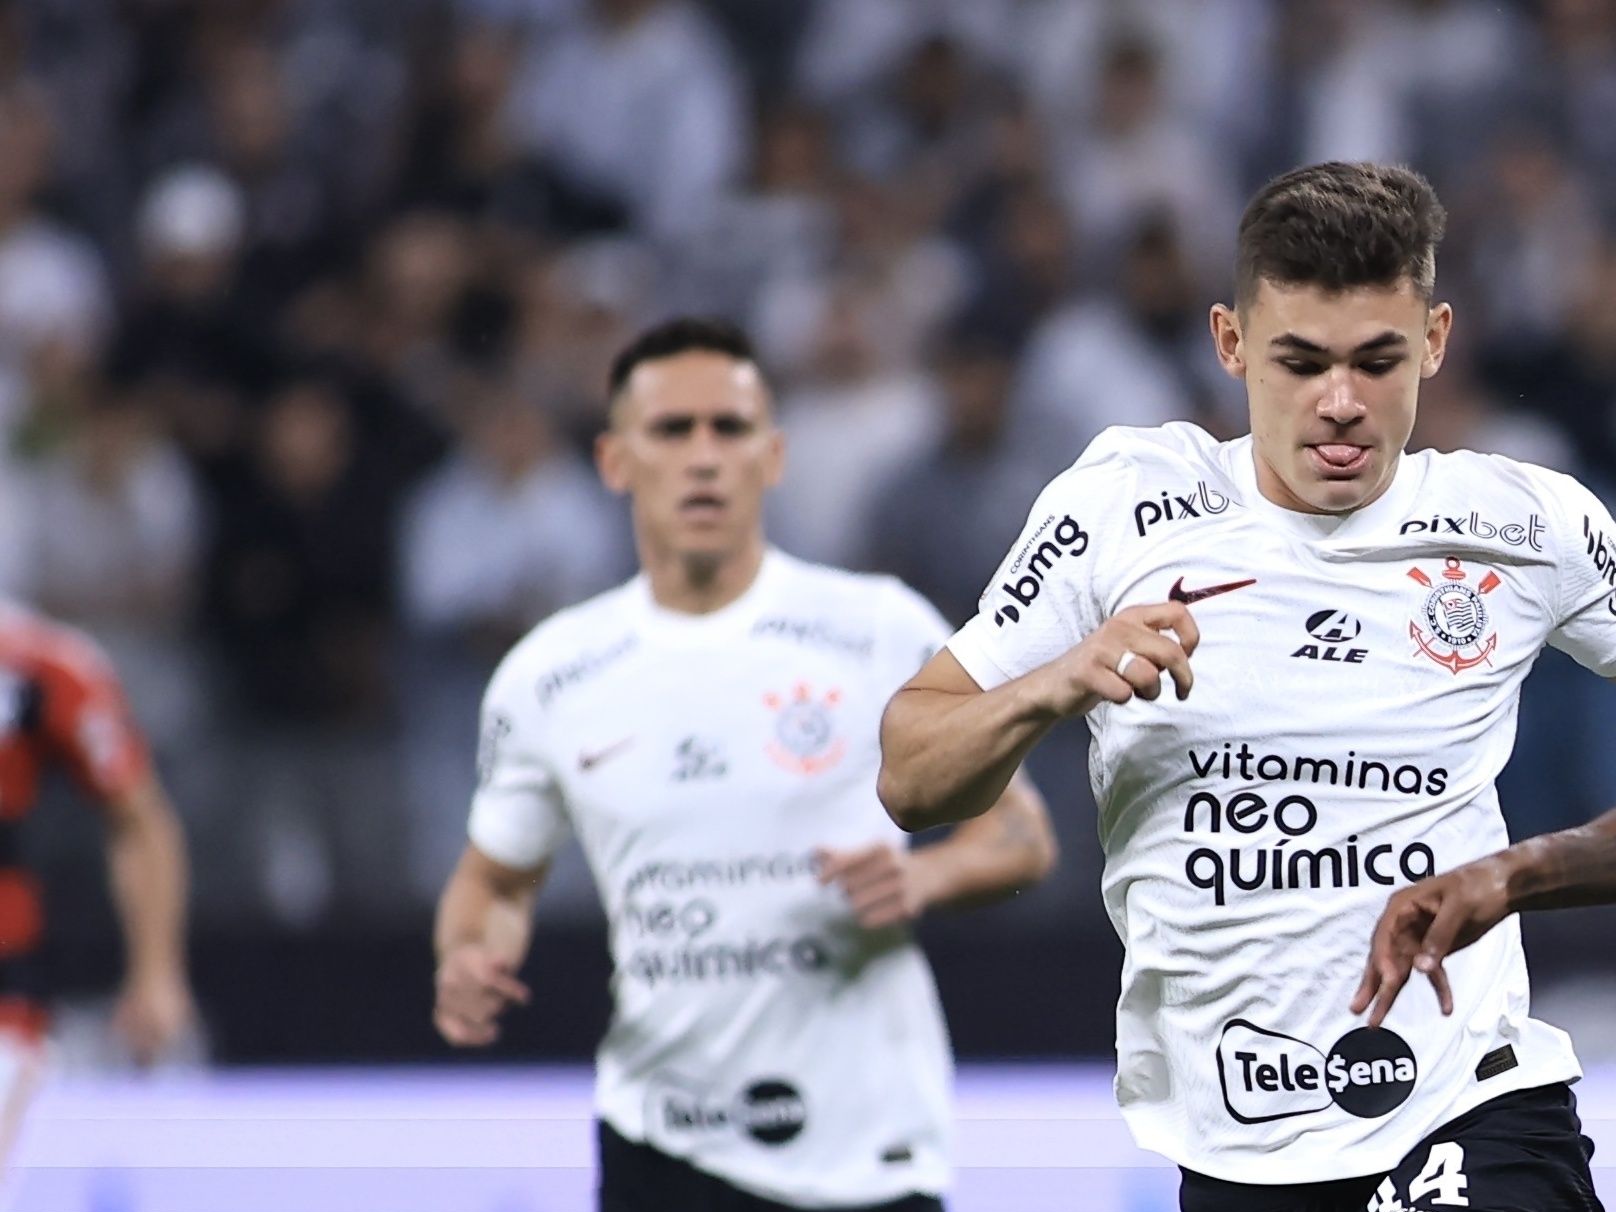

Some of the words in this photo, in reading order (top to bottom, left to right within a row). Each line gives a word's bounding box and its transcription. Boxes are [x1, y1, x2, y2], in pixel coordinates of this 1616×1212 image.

[1134, 480, 1231, 537] pixb
[1002, 514, 1089, 608] bmg
[1009, 514, 1055, 574] CORINTHIANS
[1290, 644, 1369, 664] ALE
[1188, 743, 1449, 796] vitaminas
[1184, 792, 1318, 837] neo
[1185, 834, 1436, 906] química
